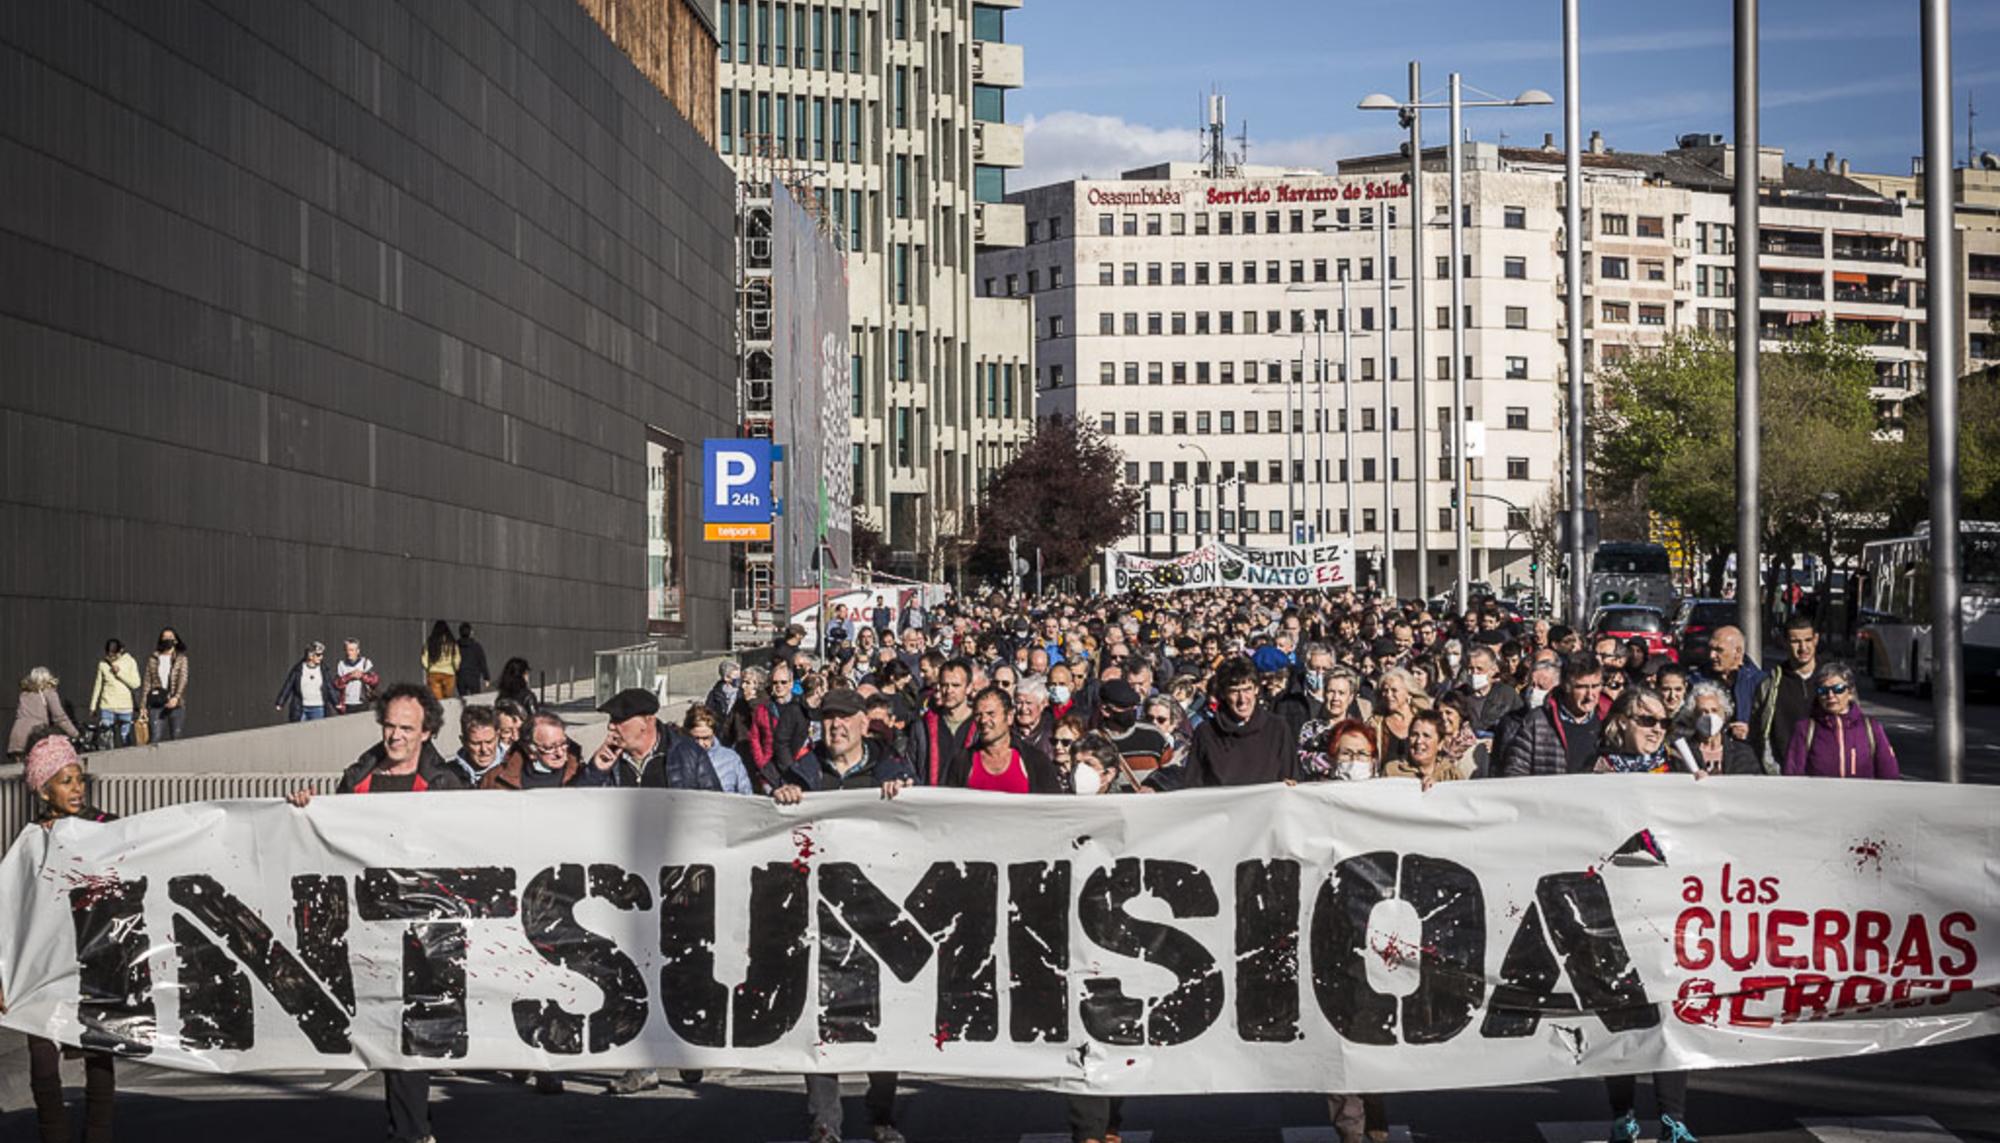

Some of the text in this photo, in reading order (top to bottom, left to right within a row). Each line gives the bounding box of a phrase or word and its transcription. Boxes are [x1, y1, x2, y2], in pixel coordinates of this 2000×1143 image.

[1088, 187, 1181, 206] Osasunbidea
[1206, 179, 1409, 205] Servicio Navarro de Salud
[715, 451, 757, 506] P
[731, 493, 760, 506] 24h
[717, 526, 757, 538] telpark
[1248, 545, 1341, 567] PUTIN EZ
[1247, 564, 1344, 586] NATO EZ
[1681, 863, 1780, 904] a las
[1674, 906, 1978, 977] GUERRAS
